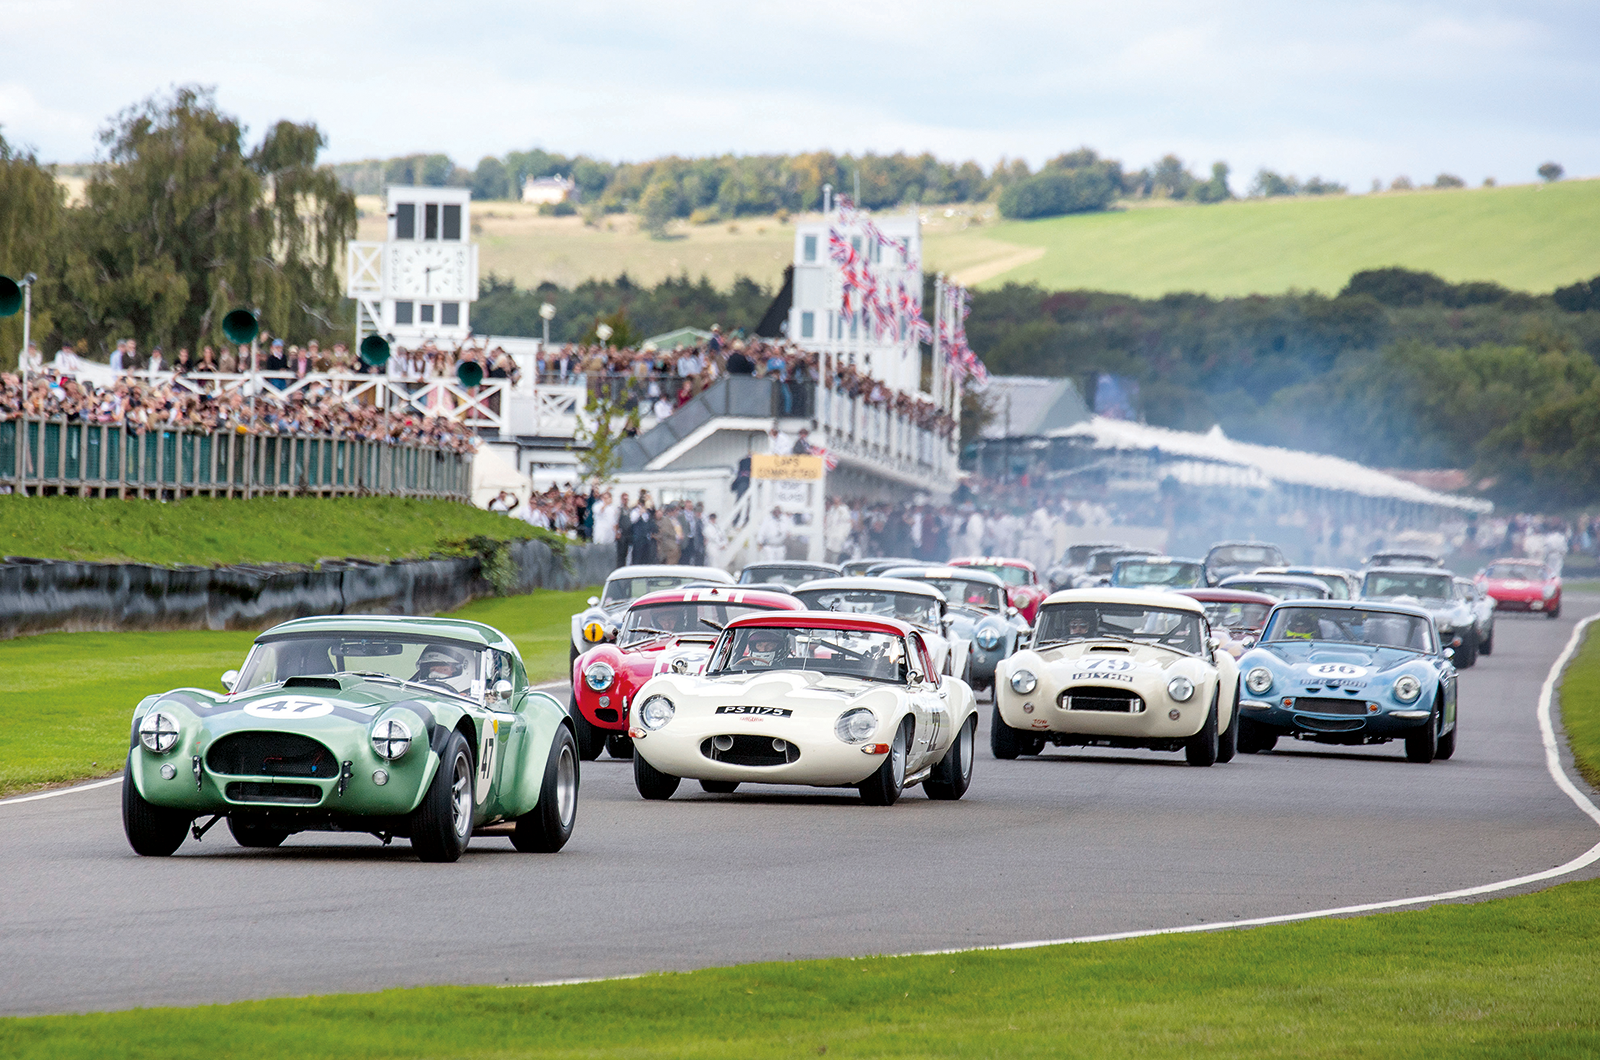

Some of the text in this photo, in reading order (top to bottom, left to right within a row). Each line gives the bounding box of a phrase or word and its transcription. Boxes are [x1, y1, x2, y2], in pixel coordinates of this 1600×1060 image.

[774, 454, 800, 466] LAPS
[757, 467, 818, 478] COMPLETED
[1085, 658, 1130, 671] 79
[1319, 665, 1356, 674] 86
[258, 699, 321, 713] 47
[724, 706, 784, 716] PS 1175
[481, 738, 494, 779] 47
